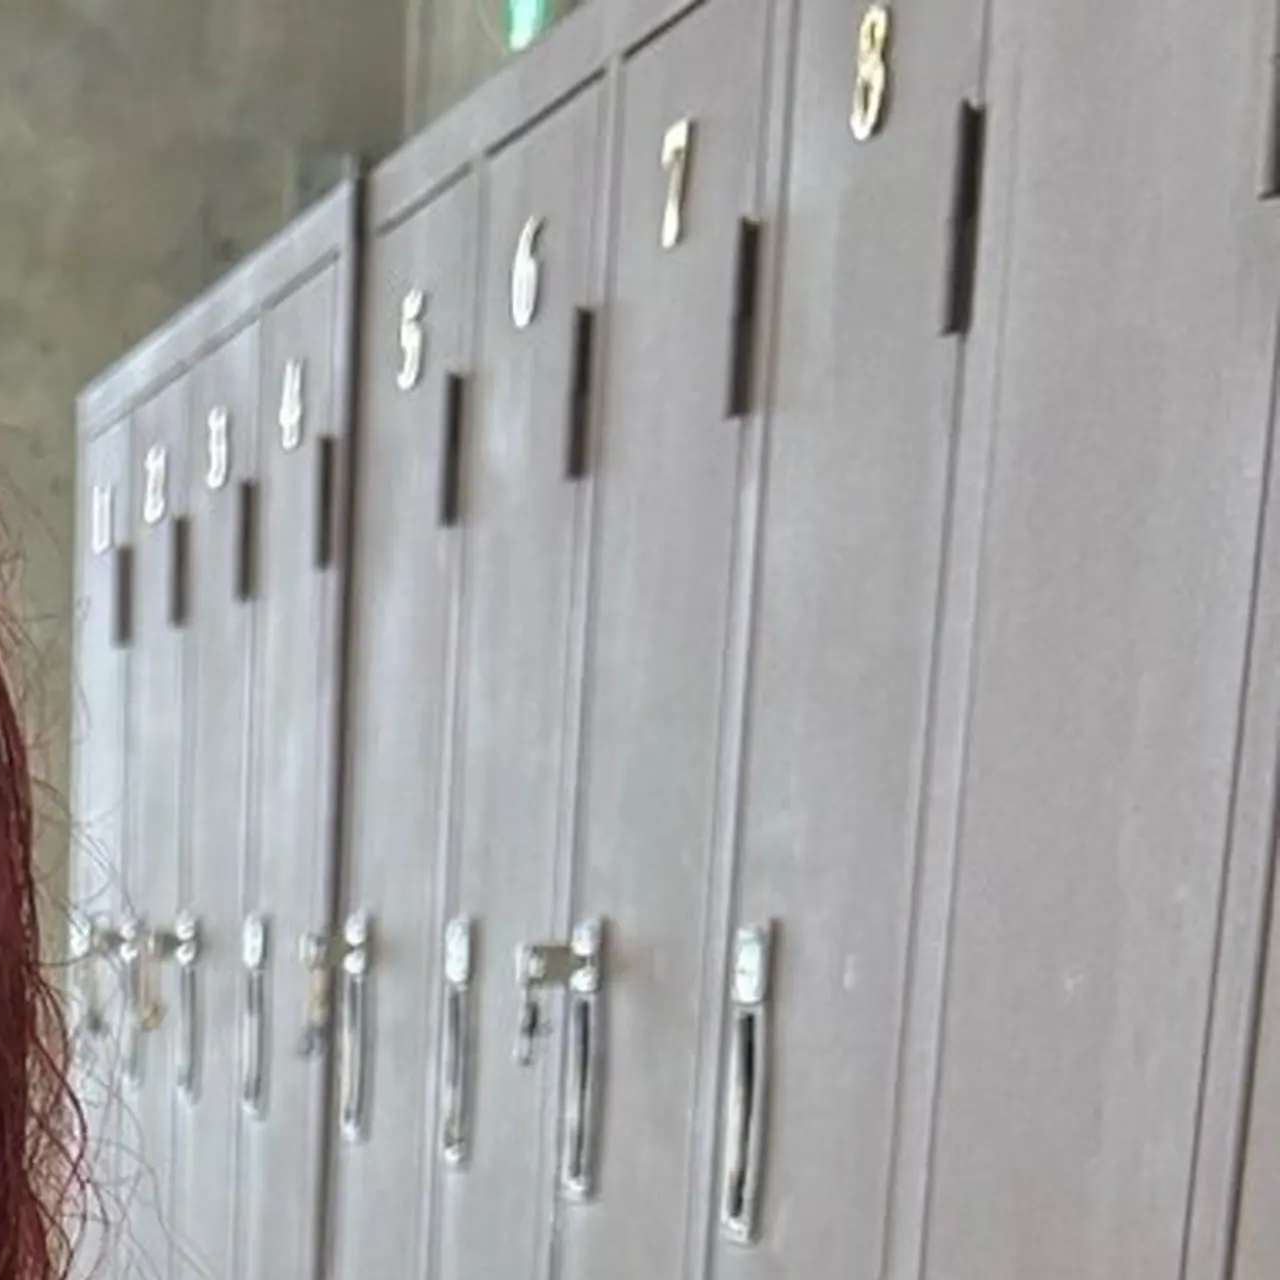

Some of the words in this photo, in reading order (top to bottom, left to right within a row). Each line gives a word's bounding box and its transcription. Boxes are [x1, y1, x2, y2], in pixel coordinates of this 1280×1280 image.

[850, 4, 887, 141] 8
[661, 117, 690, 248] 7
[512, 215, 539, 328] 6
[397, 287, 423, 390] 5
